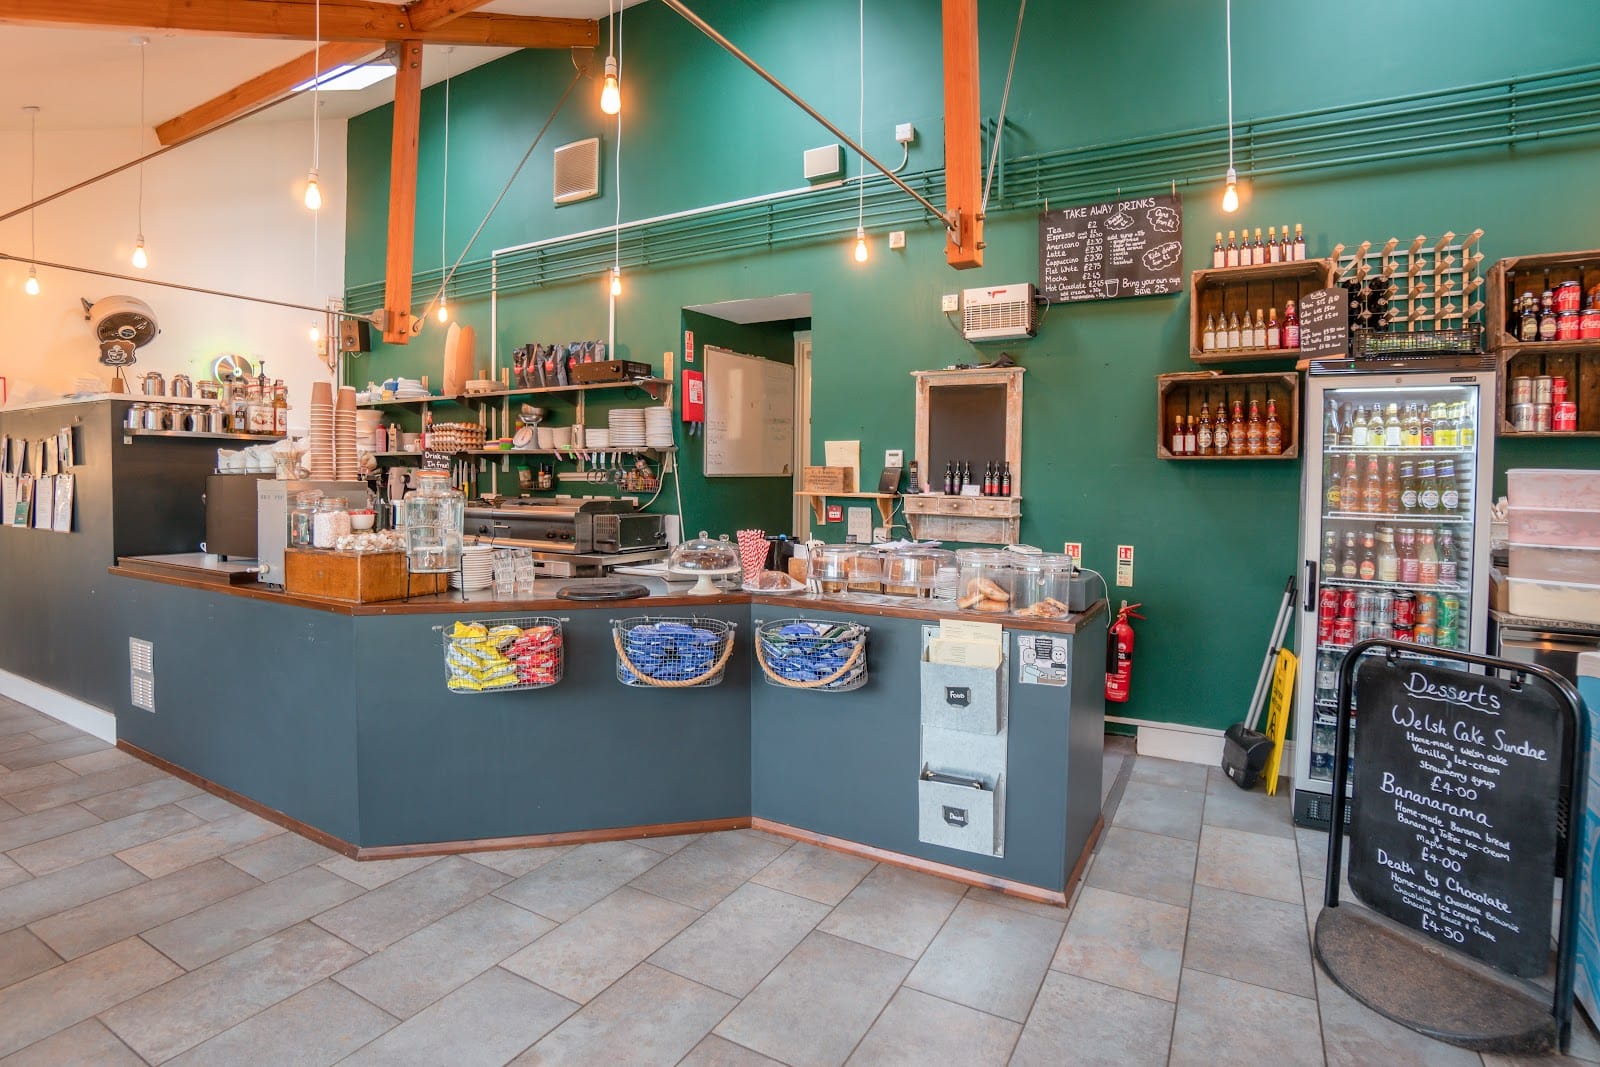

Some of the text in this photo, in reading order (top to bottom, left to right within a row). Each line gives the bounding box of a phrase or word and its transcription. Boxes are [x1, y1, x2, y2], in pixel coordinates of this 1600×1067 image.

[1063, 198, 1156, 219] TAKE AWAY DRINKS
[1046, 232, 1076, 242] Espresso
[1046, 242, 1080, 250] Americano
[1046, 258, 1079, 267] Cappuccino
[1046, 268, 1058, 276] Flat
[1060, 265, 1078, 273] White
[1046, 284, 1058, 292] Hot
[1122, 278, 1140, 288] Bring
[1142, 279, 1156, 288] your
[1155, 284, 1168, 294] 25p
[425, 452, 441, 460] Drink
[1403, 672, 1500, 709] Desserts
[1392, 704, 1547, 760] Welsh Cake Sundae
[1406, 731, 1455, 752] Home-made
[1487, 754, 1509, 766] cake
[1412, 743, 1500, 776] Vanilla Ice-cream
[1470, 776, 1496, 790] syrup
[1380, 772, 1494, 828] Bananarama
[1395, 799, 1511, 851] Home-made Banana bread
[1398, 812, 1428, 832] Banana
[1416, 834, 1468, 860] Maple syrup
[1378, 848, 1512, 914] Death by Chocolate
[1390, 871, 1442, 900] Home-made
[1393, 883, 1432, 906] Chocolate
[1452, 910, 1480, 926] cream
[1402, 896, 1437, 916] Chocolate
